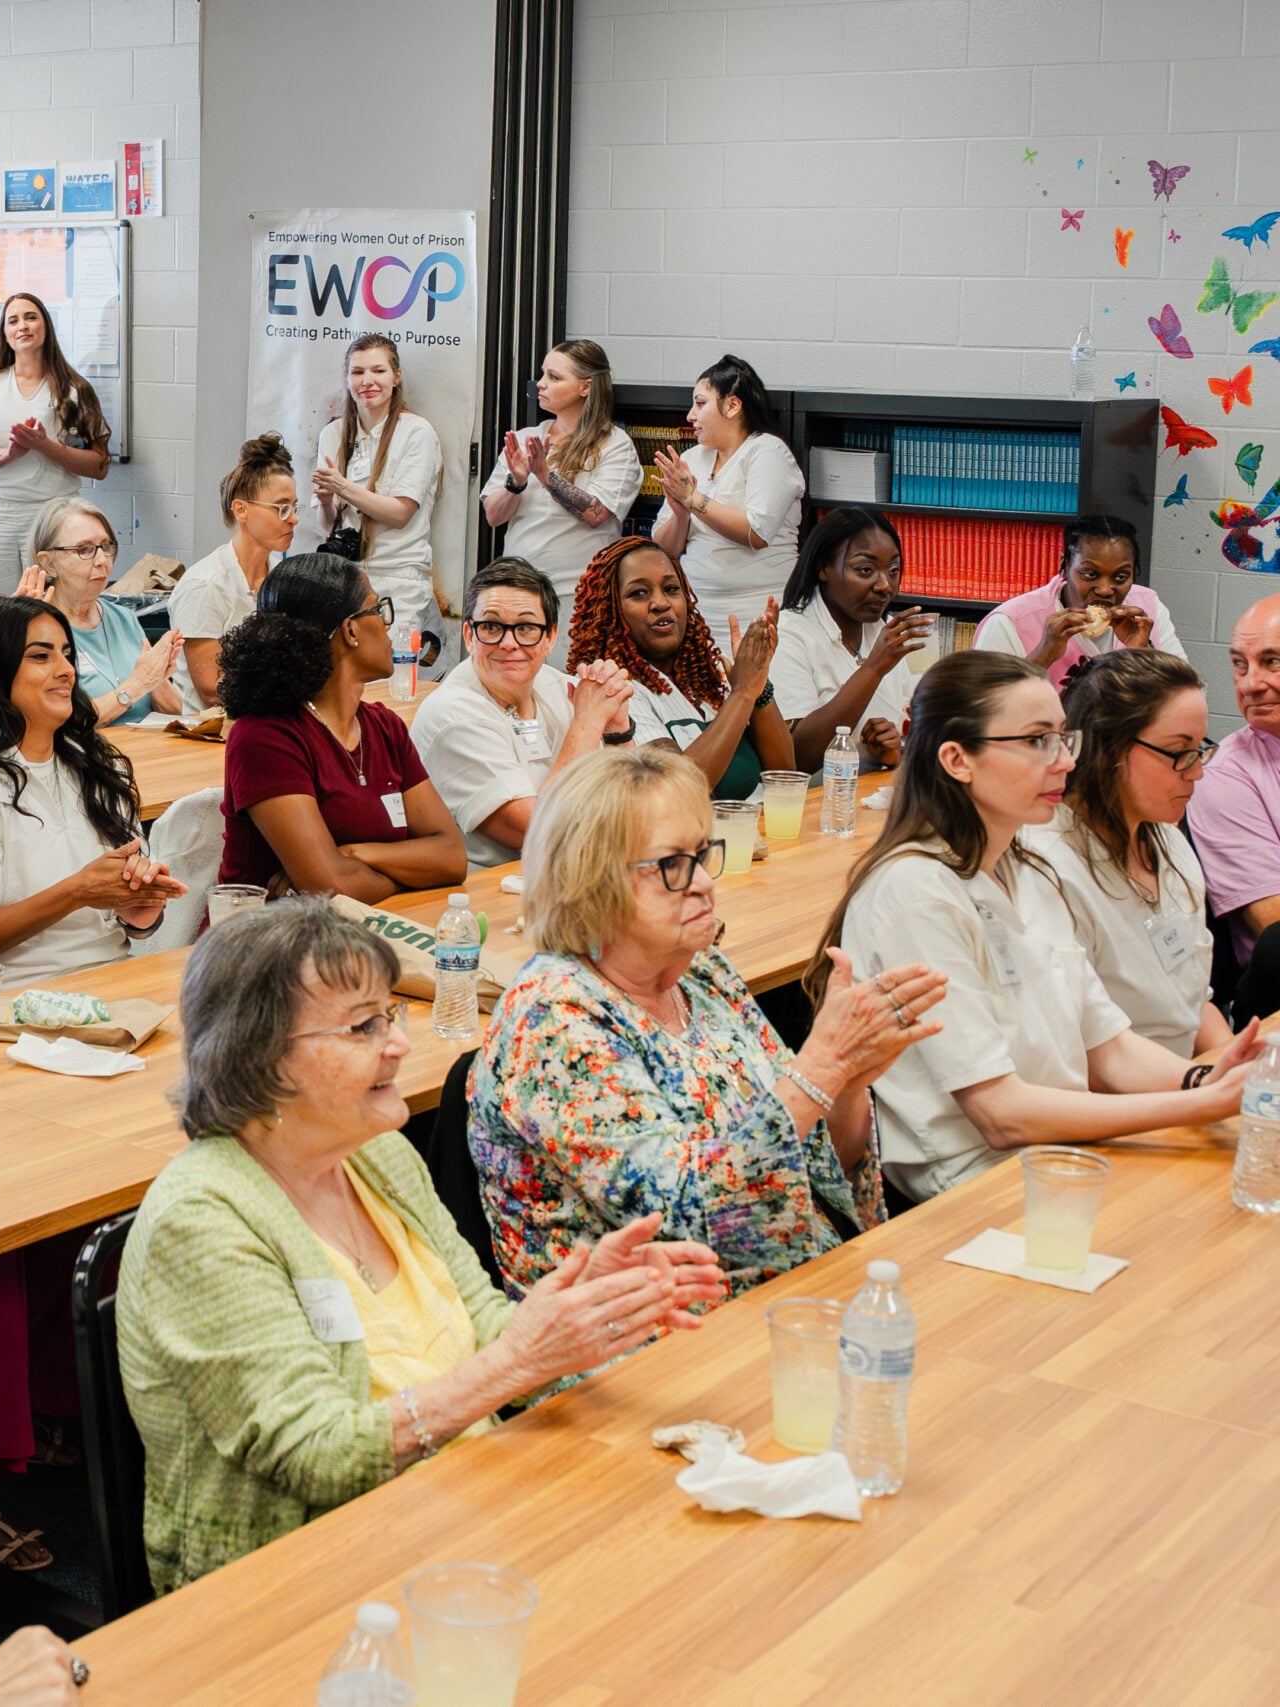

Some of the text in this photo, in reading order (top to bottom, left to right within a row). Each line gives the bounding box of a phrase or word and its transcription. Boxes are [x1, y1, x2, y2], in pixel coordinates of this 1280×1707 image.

[268, 231, 465, 246] Empowering Women Out of Prison
[266, 324, 318, 341] Creating
[388, 330, 401, 344] to
[406, 331, 461, 347] Purpose
